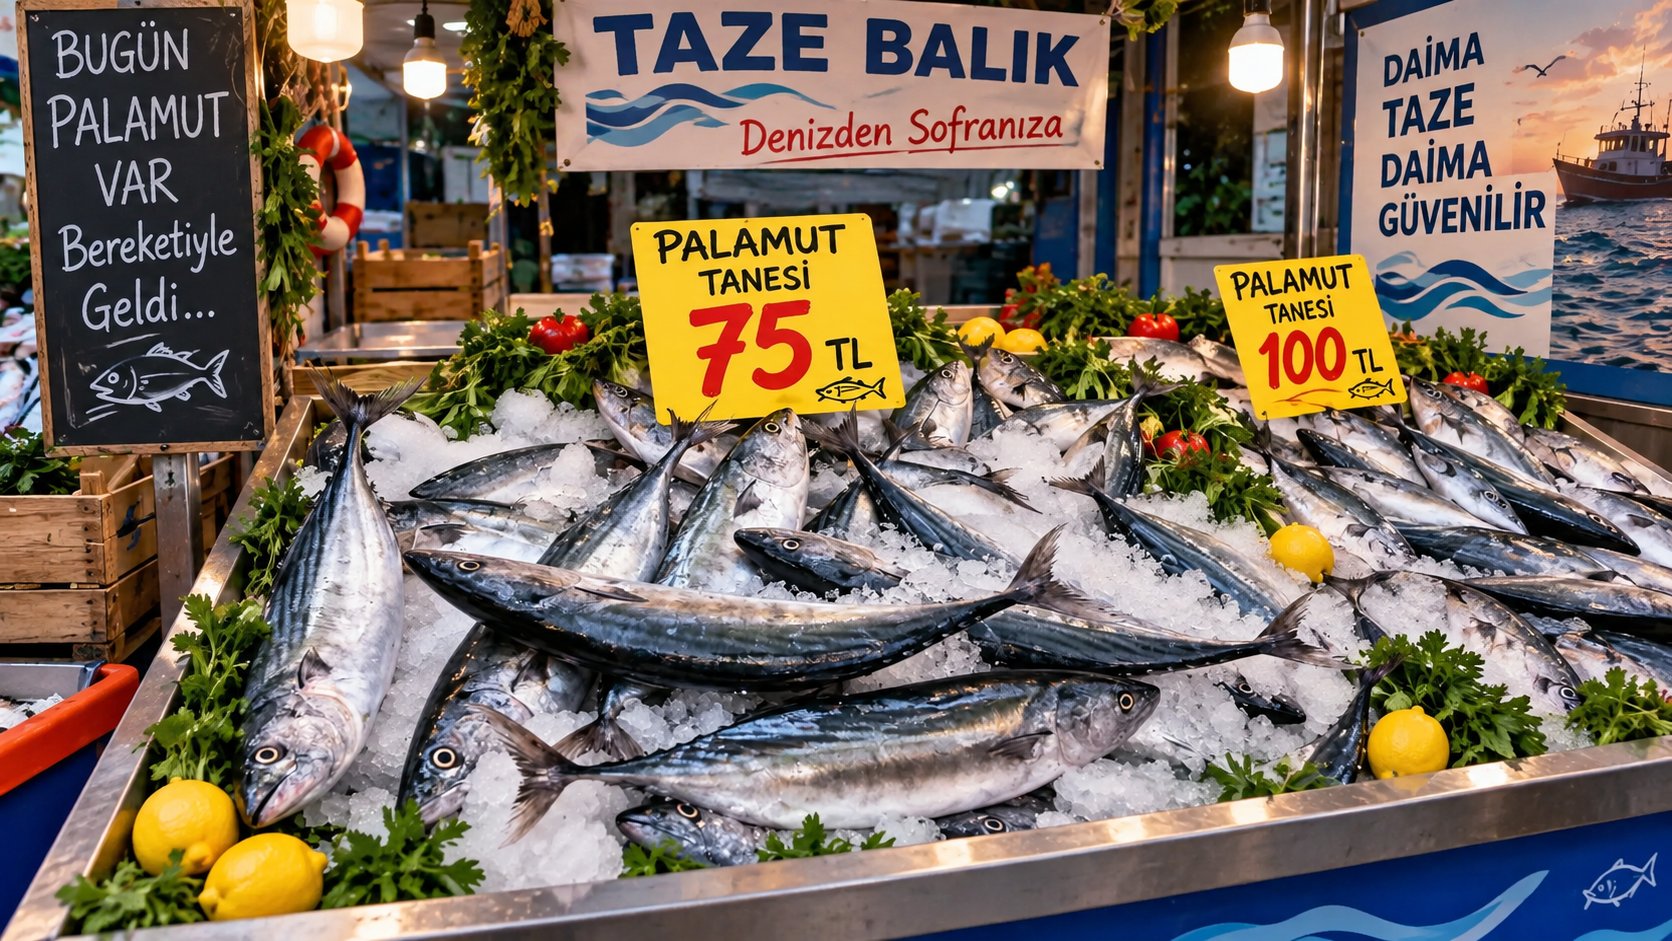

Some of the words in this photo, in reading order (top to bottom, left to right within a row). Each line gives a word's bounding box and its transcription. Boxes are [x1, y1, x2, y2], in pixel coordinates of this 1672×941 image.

[51, 21, 189, 79] BUGÜN
[593, 11, 829, 76] TAZE
[865, 17, 1081, 87] BALIK
[1383, 31, 1485, 88] DAİMA
[47, 91, 229, 149] PALAMUT
[739, 111, 892, 156] Denizden
[907, 105, 1063, 153] Sofranıza
[1382, 82, 1475, 138] TAZE
[94, 158, 179, 206] VAR
[1381, 138, 1493, 189] DAİMA
[1379, 181, 1546, 237] GÜVENİLİR
[57, 212, 238, 274] Bereketiyle
[653, 223, 846, 264] PALAMUT
[81, 276, 215, 332] Geldi...
[698, 259, 811, 296] TANESİ
[1230, 263, 1353, 301] PALAMUT
[1263, 294, 1335, 324] TANESİ
[689, 300, 812, 398] 75
[825, 337, 873, 371] TL
[1258, 326, 1347, 390] 100
[1352, 348, 1384, 374] TL
